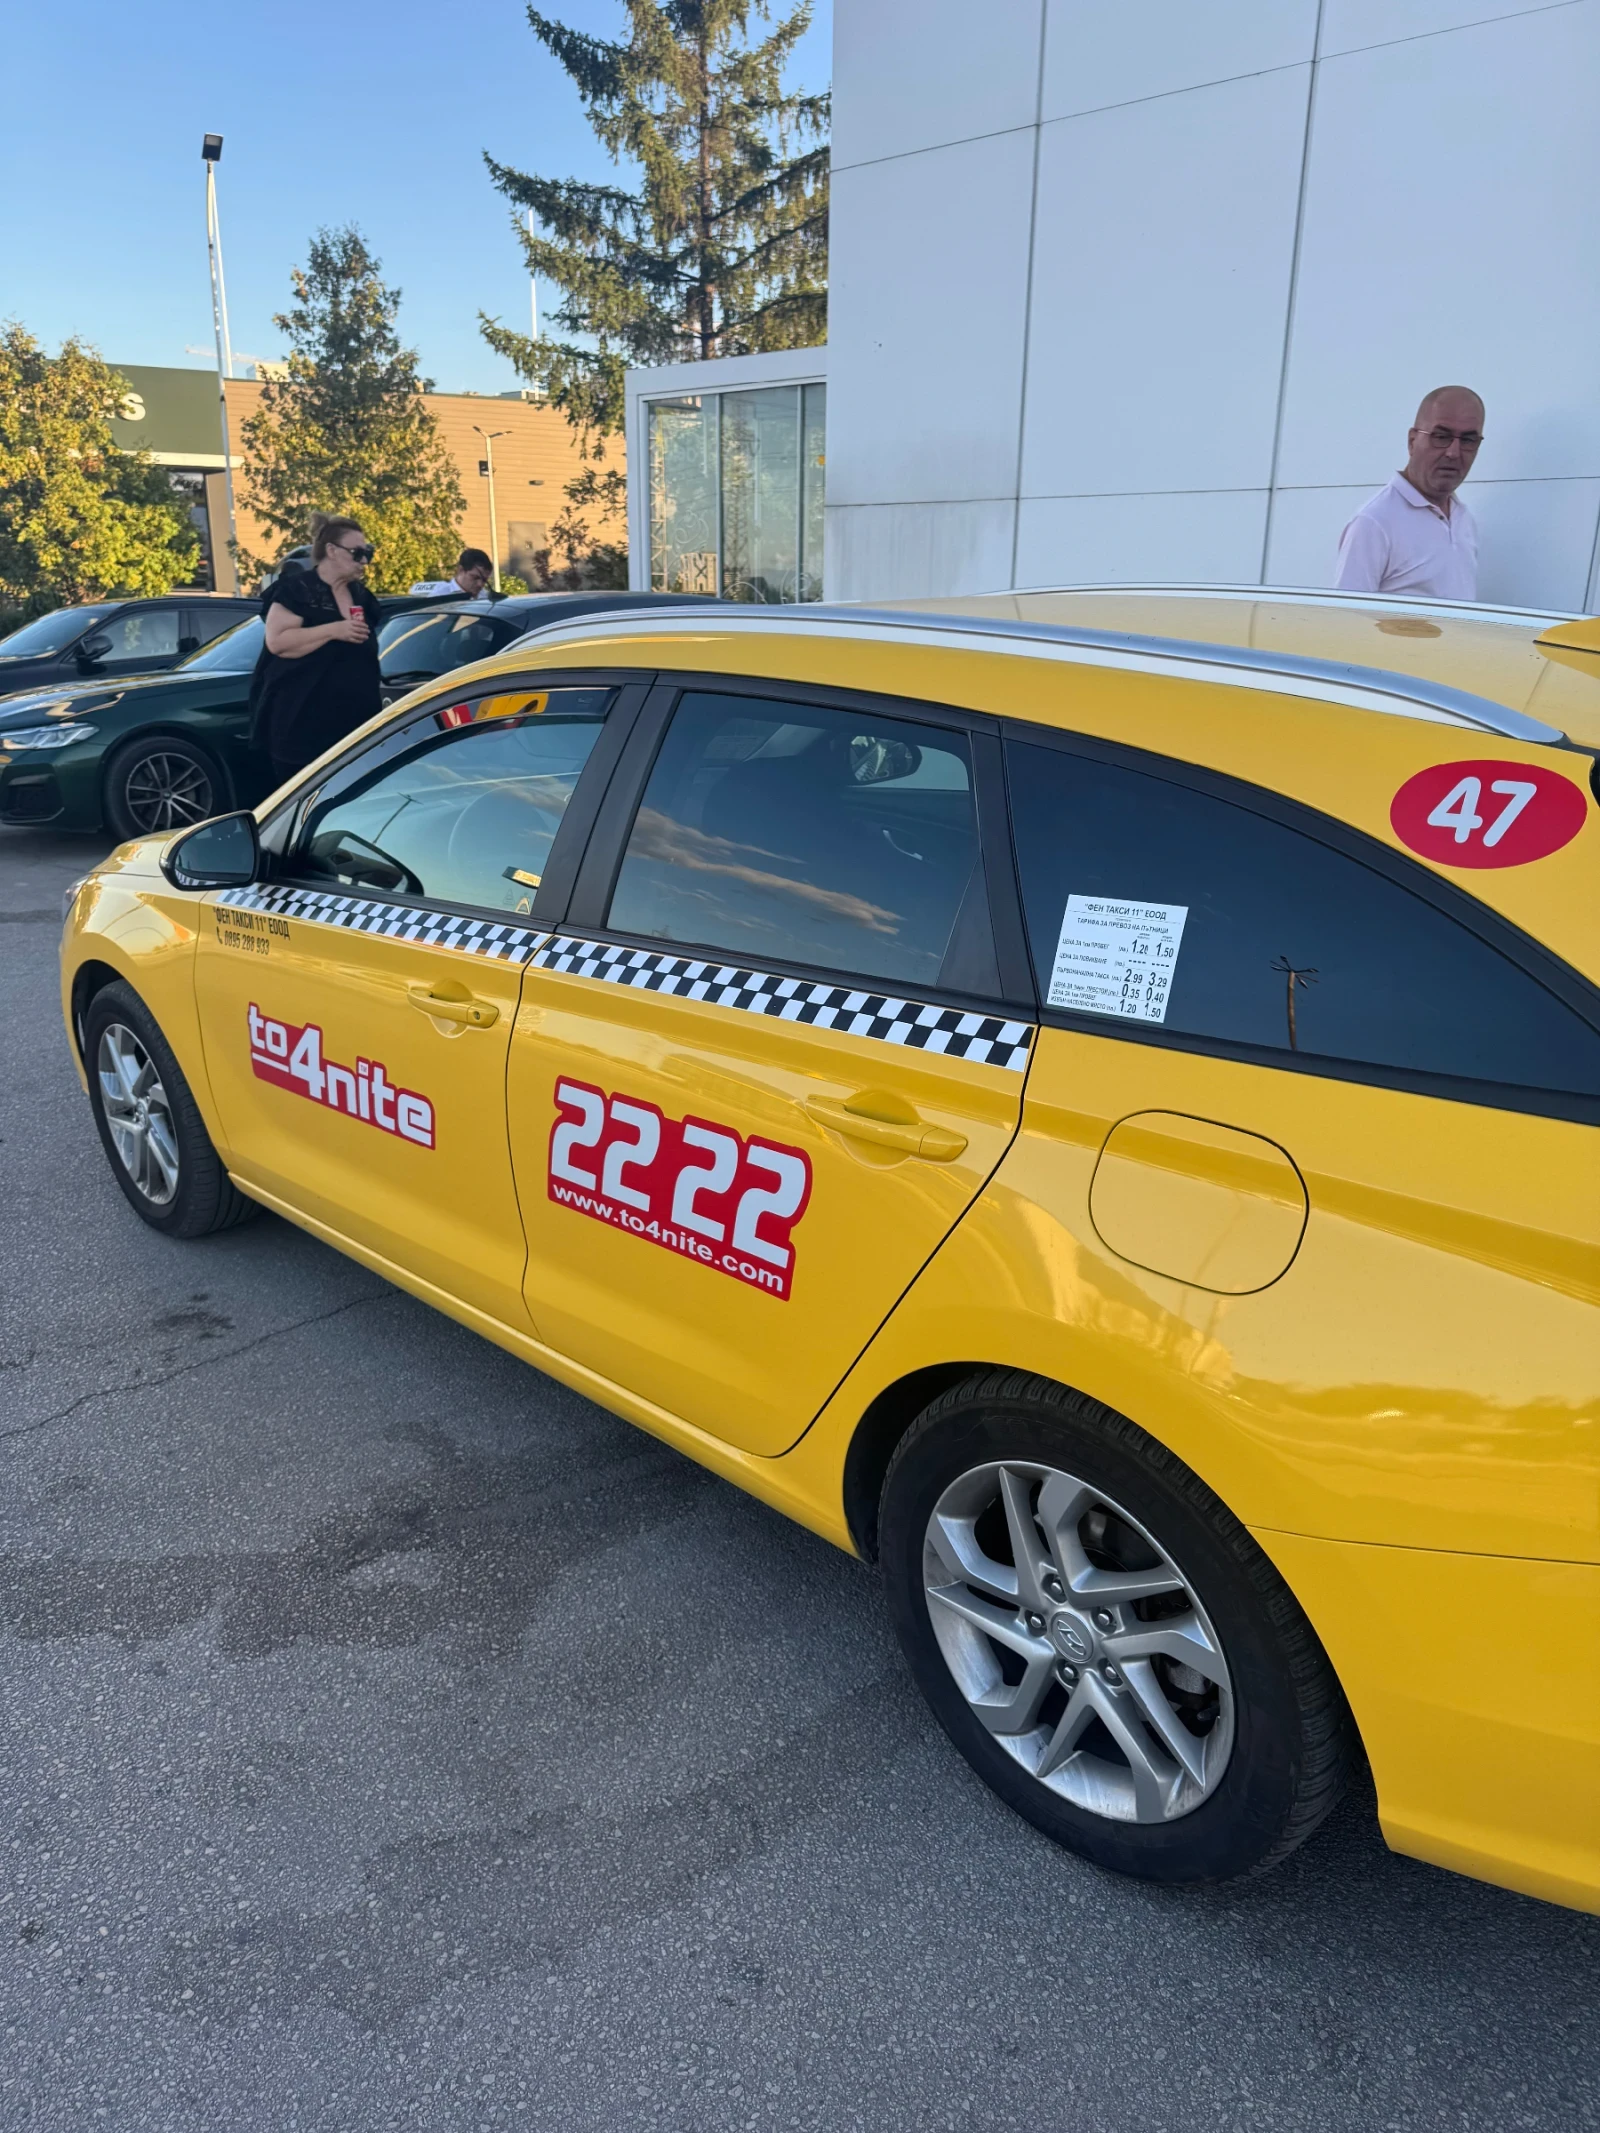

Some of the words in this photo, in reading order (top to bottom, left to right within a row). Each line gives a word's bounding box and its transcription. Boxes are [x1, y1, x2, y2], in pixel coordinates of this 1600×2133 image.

[1427, 776, 1538, 848] 47
[1106, 905, 1130, 916] ТАКСИ
[1144, 910, 1167, 920] ЕООД
[231, 910, 254, 930] ТАКСИ
[268, 918, 291, 941] ЕООД
[1077, 917, 1100, 926] ТАРИФА
[1108, 921, 1131, 930] ПРЕВОЗ
[224, 930, 241, 949] 0895
[242, 934, 255, 952] 288
[256, 937, 270, 956] 933
[1132, 939, 1149, 955] 1.20
[1156, 942, 1174, 958] 1.50
[1124, 968, 1143, 984] 2.99
[1148, 972, 1168, 988] 3.29
[1121, 983, 1140, 999] 0.35
[1146, 987, 1165, 1004] 0.40
[1120, 998, 1137, 1014] 1.20
[1144, 1002, 1162, 1018] 1.50
[249, 1005, 432, 1146] to4nite
[553, 1184, 784, 1293] www.to4nite.com
